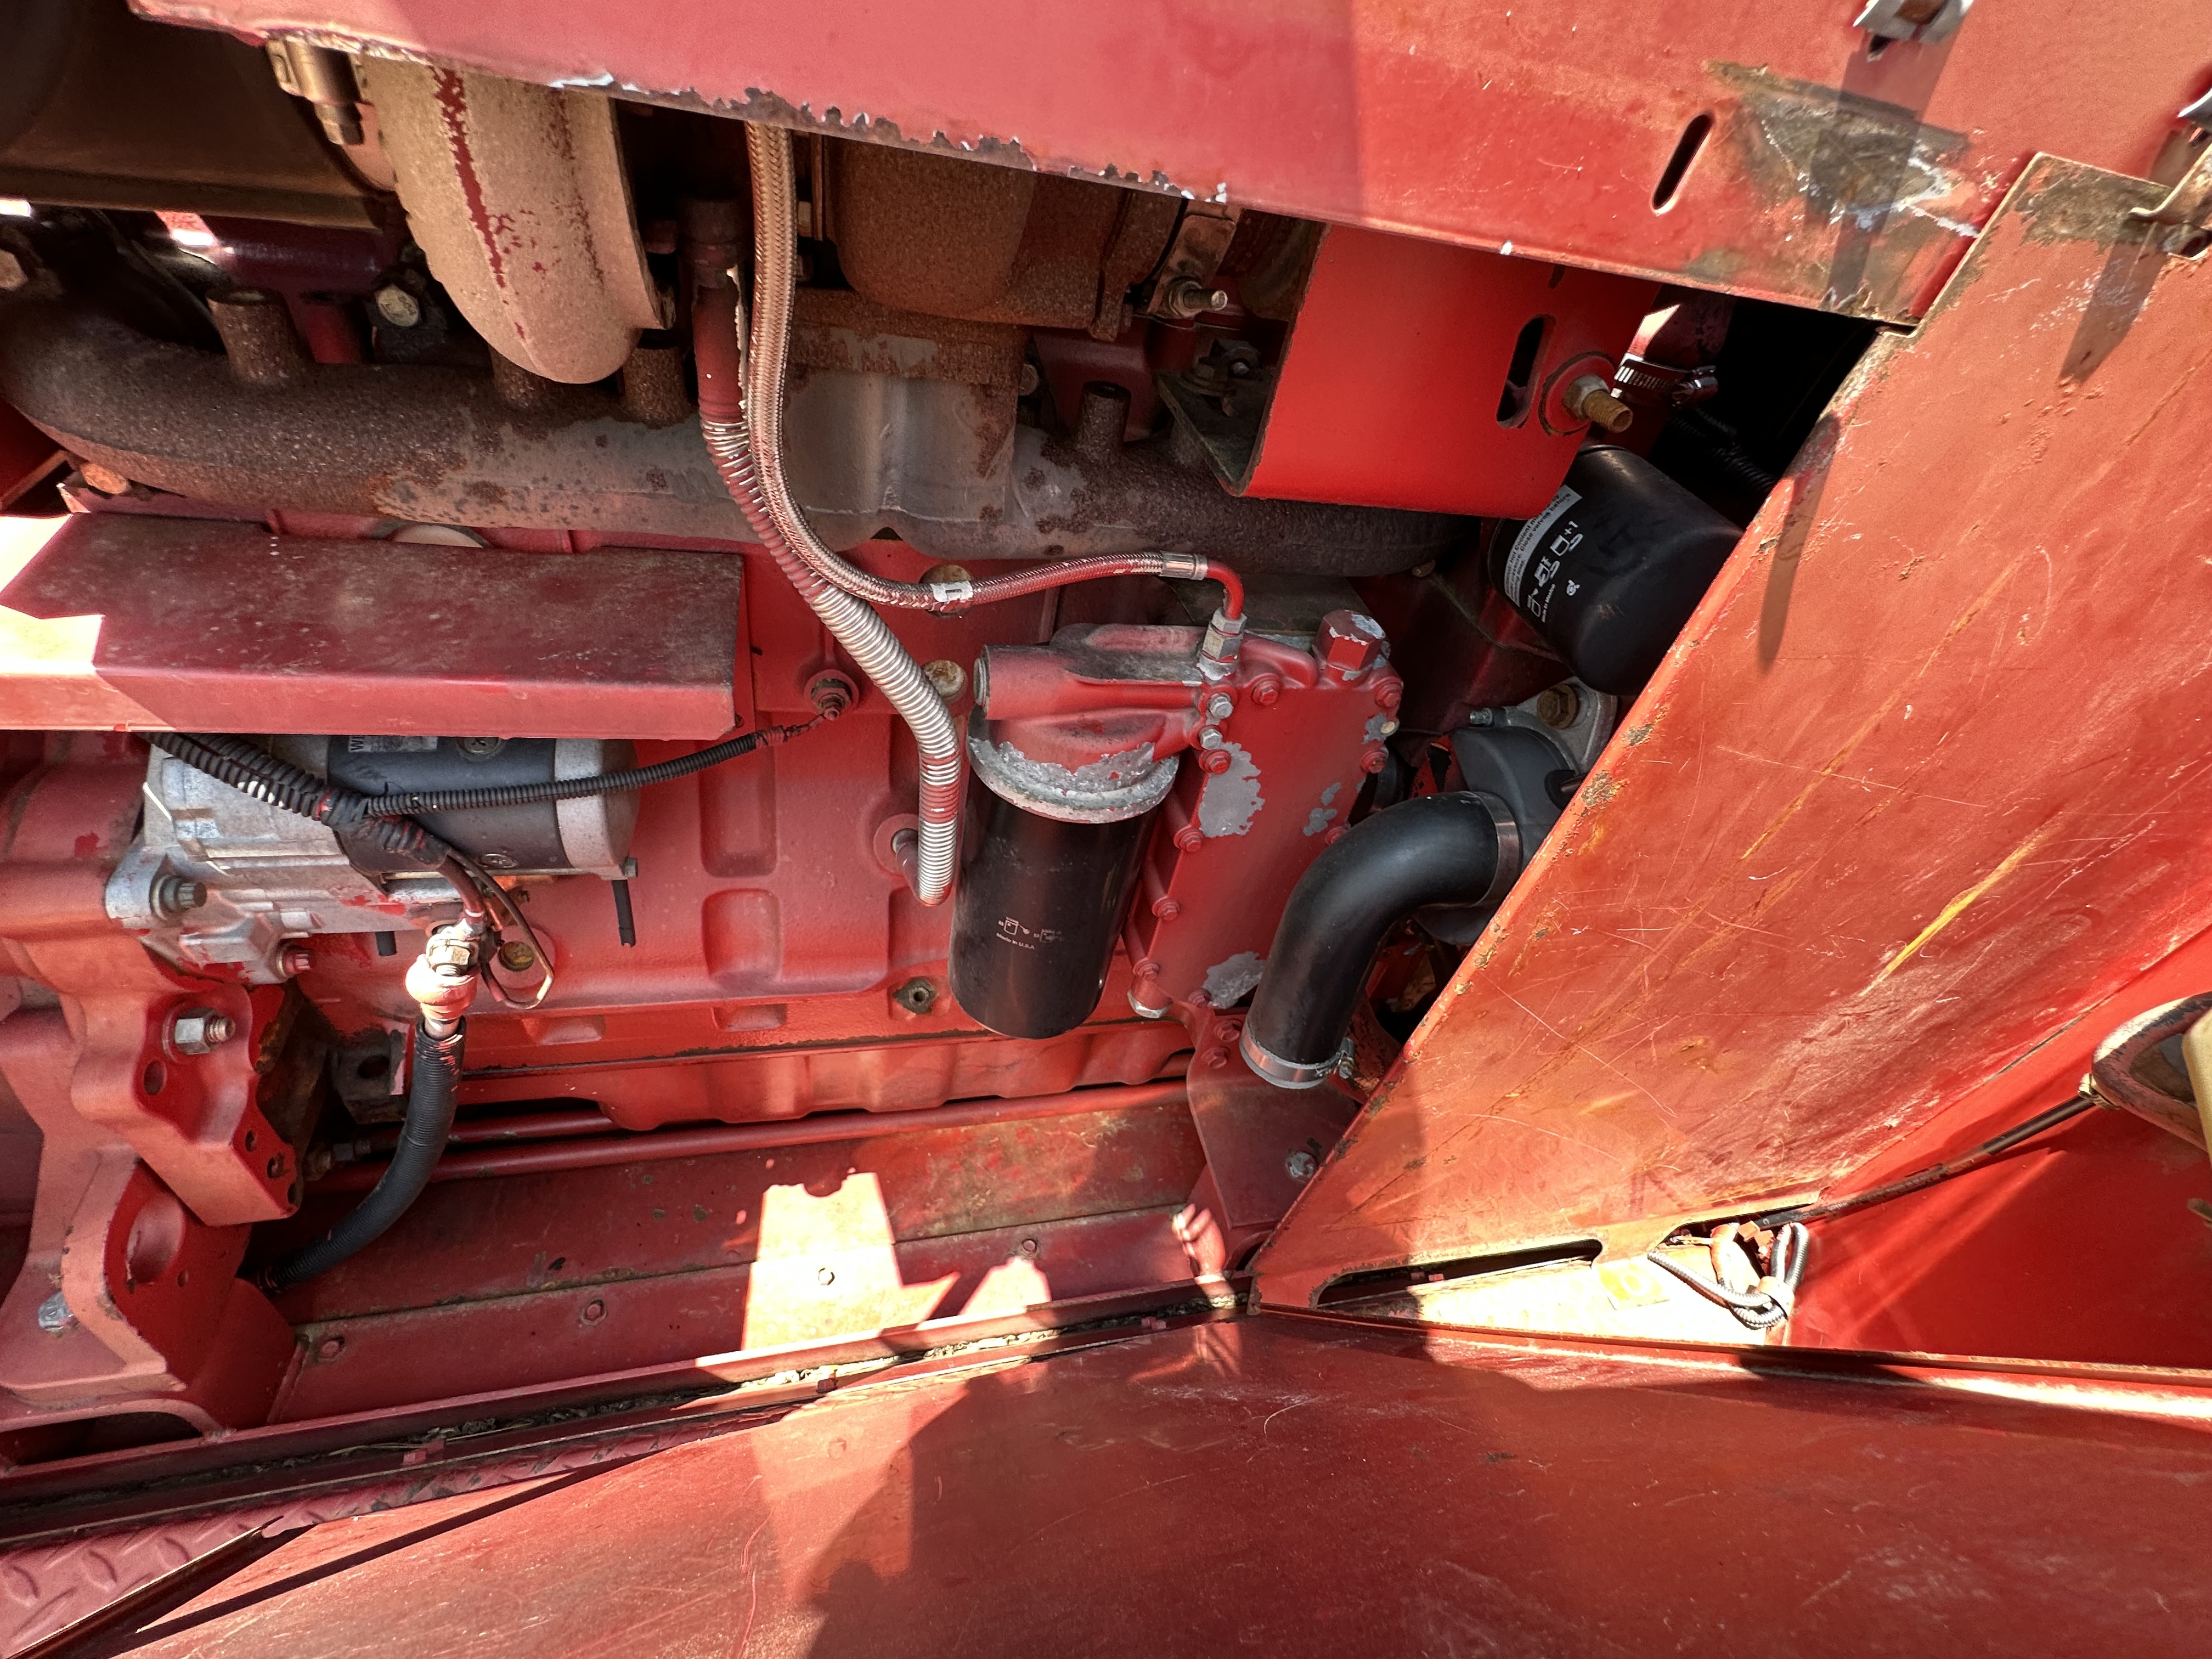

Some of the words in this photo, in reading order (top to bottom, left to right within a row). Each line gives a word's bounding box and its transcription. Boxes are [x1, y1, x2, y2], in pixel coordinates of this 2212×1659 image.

[1515, 525, 1531, 551] Coolant
[1520, 533, 1534, 552] Close
[1533, 511, 1551, 532] valves
[1549, 493, 1571, 511] before
